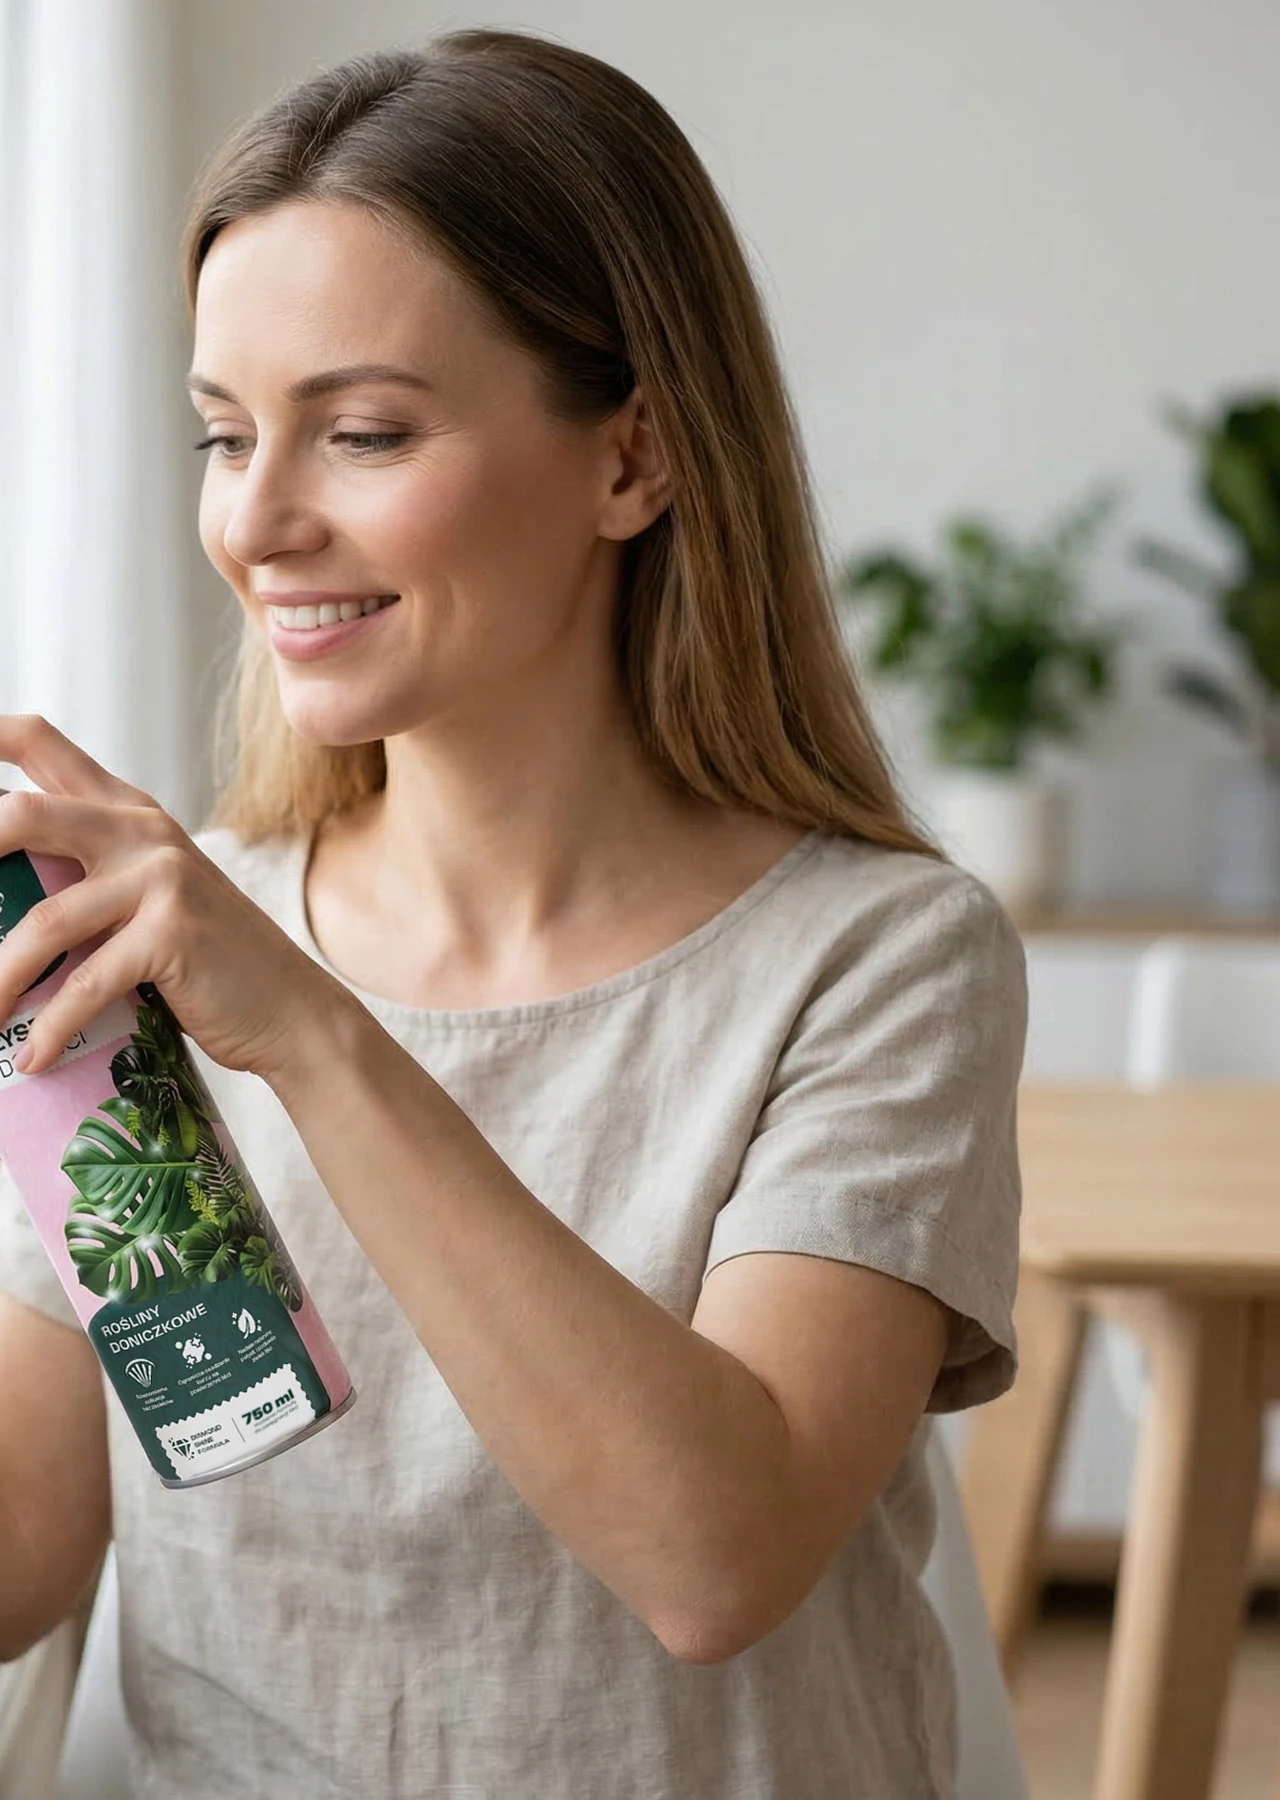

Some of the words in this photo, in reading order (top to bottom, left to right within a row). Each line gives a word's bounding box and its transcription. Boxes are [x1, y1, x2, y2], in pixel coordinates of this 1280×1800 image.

[100, 1304, 160, 1337] ROŚLINY
[109, 1302, 208, 1354] DONICZKOWE
[241, 1401, 274, 1426] 750
[274, 1388, 295, 1408] ml
[190, 1424, 222, 1441] DIAMOND
[194, 1436, 214, 1448] SHINE
[197, 1438, 231, 1454] FORMULA
